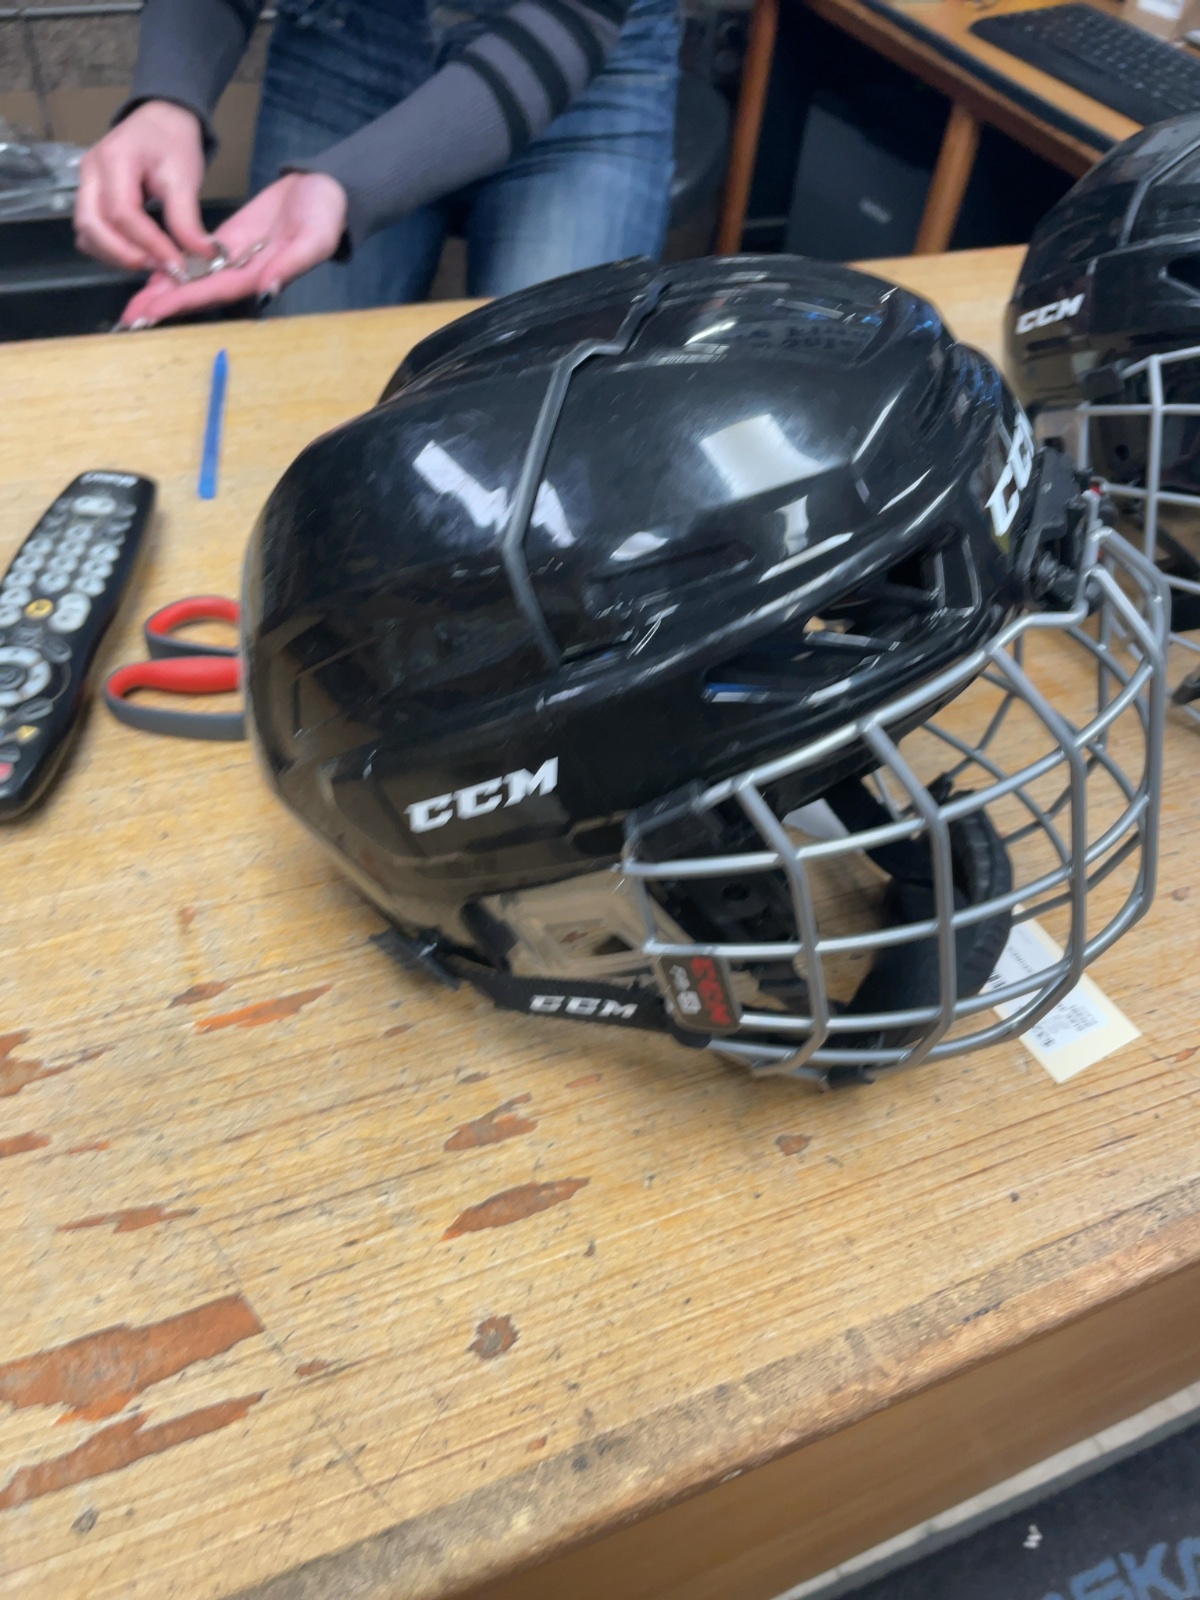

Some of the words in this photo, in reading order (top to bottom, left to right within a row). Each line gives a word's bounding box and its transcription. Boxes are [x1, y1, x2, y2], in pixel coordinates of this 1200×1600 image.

[1016, 293, 1085, 335] CCM
[985, 411, 1034, 537] CC
[404, 756, 558, 833] CCM
[529, 994, 638, 1019] CCM
